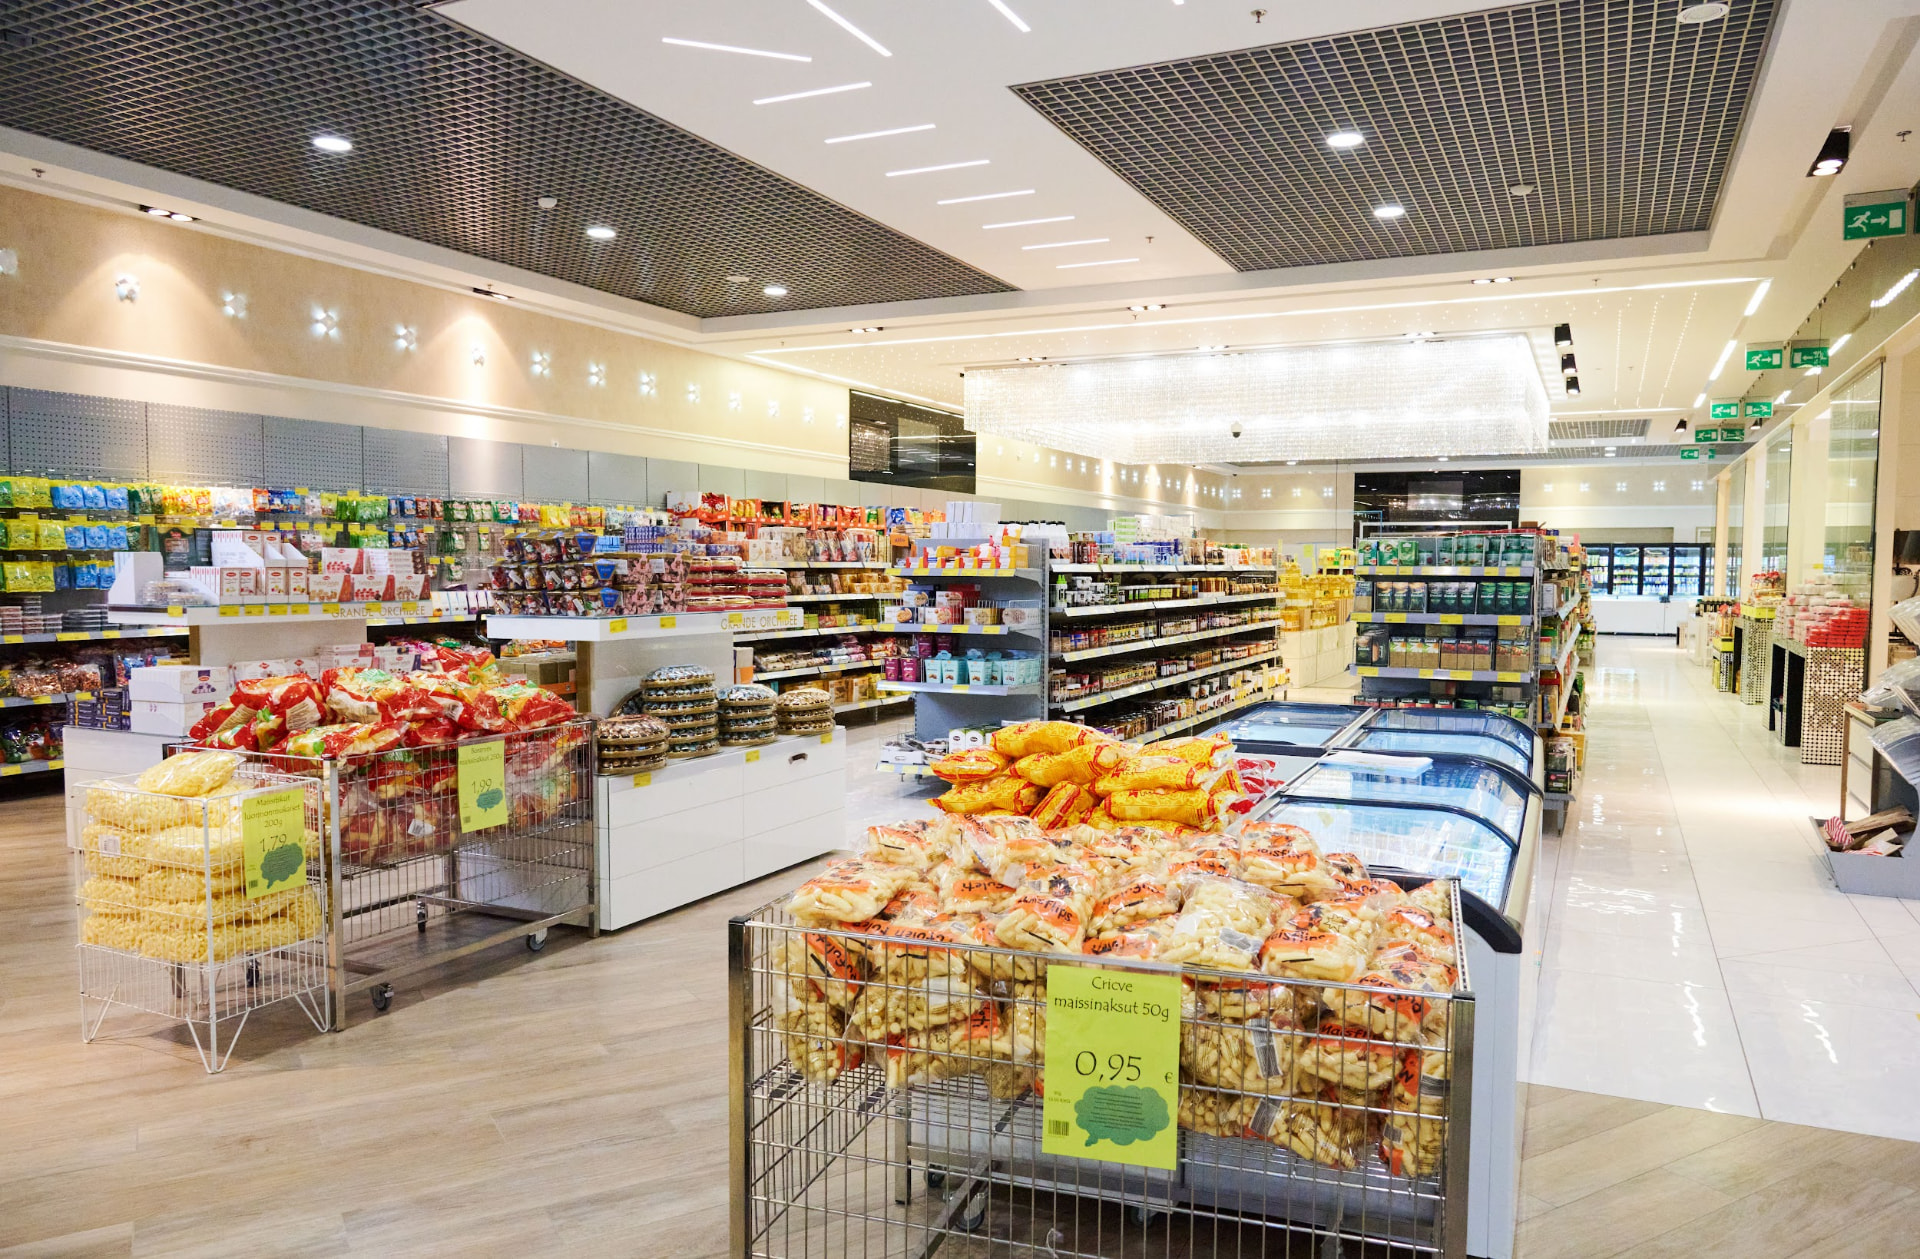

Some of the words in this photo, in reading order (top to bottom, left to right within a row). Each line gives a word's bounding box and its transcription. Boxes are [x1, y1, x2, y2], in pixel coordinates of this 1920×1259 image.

[471, 778, 492, 794] 1,99
[263, 819, 283, 828] 200g
[259, 833, 287, 853] 1,79
[1091, 976, 1133, 993] Cricve
[1054, 997, 1139, 1015] maissinaksut
[1142, 1002, 1169, 1022] 50g
[1075, 1050, 1142, 1082] 0,95
[1164, 1071, 1173, 1084] €
